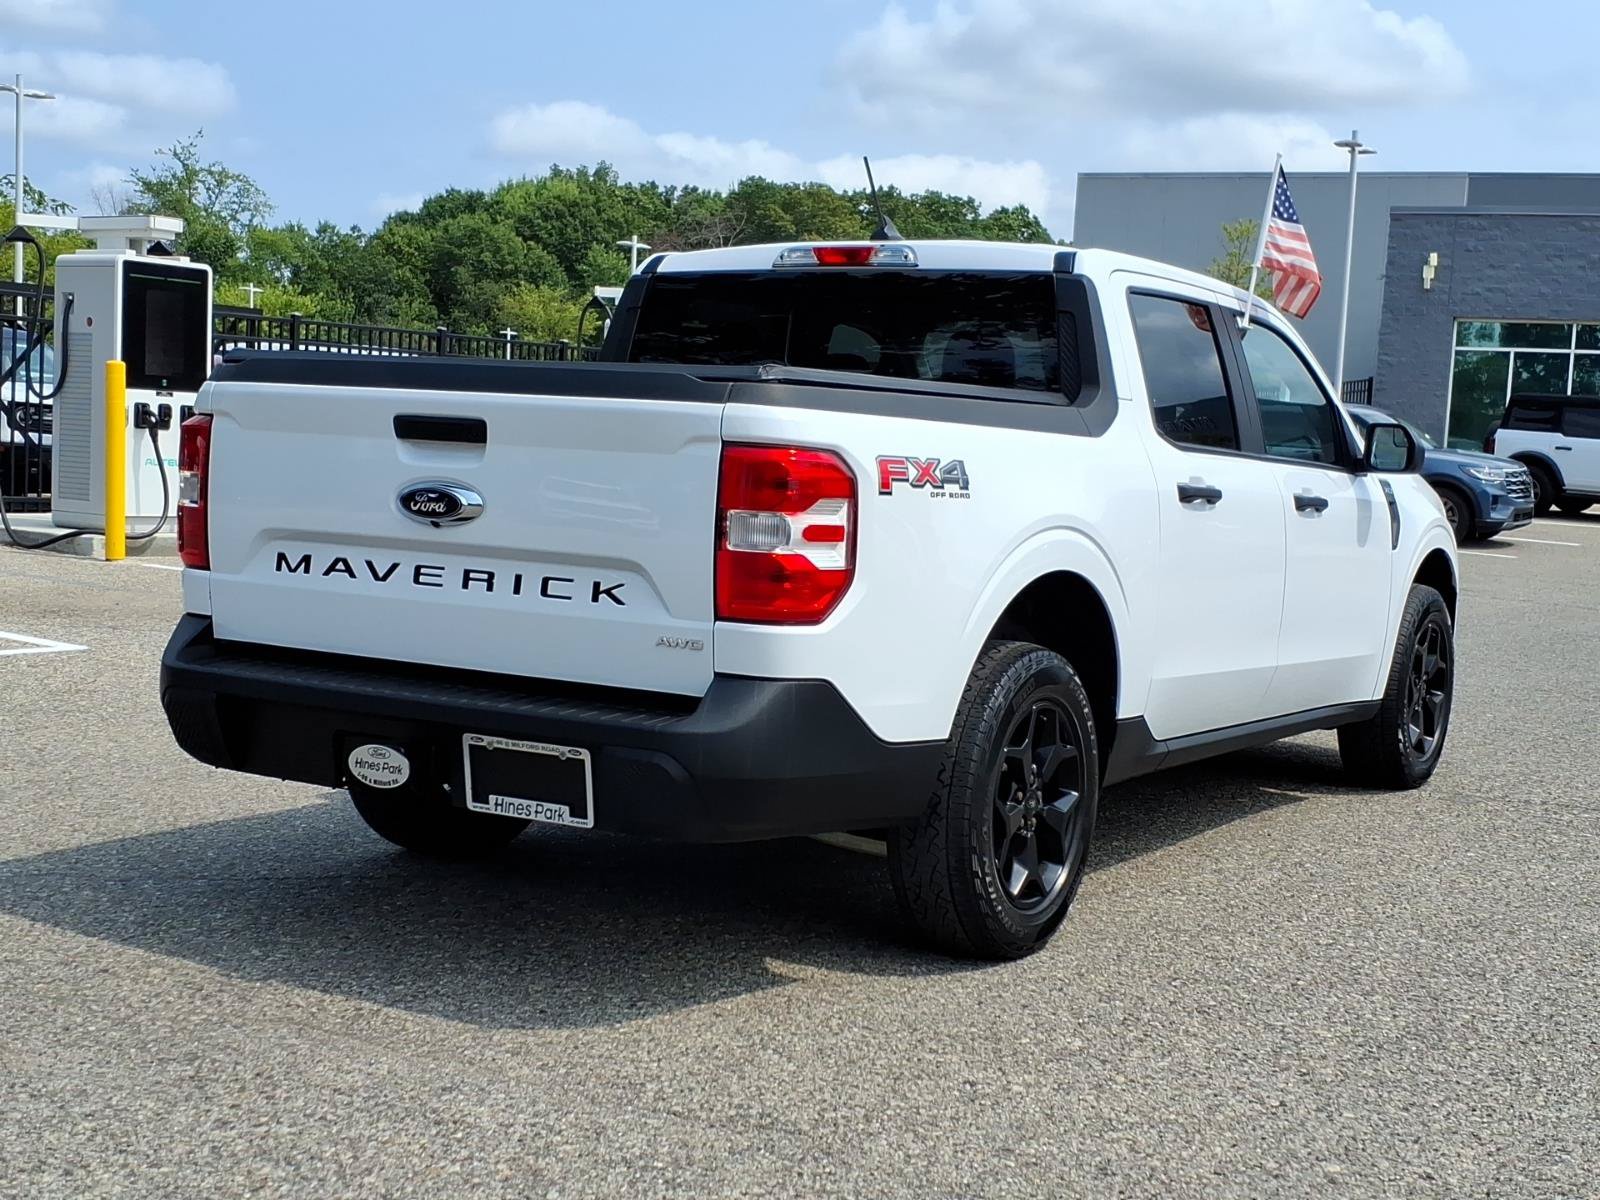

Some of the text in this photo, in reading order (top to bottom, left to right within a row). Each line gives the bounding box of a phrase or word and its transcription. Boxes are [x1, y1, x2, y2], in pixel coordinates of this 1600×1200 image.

[875, 455, 970, 496] FX4
[410, 491, 448, 513] Ford
[930, 491, 947, 499] OFF
[274, 551, 626, 606] MAVERICK
[511, 741, 540, 751] MILFORD
[355, 757, 403, 775] Hines Park
[494, 796, 531, 817] Hines
[534, 802, 565, 822] Park
